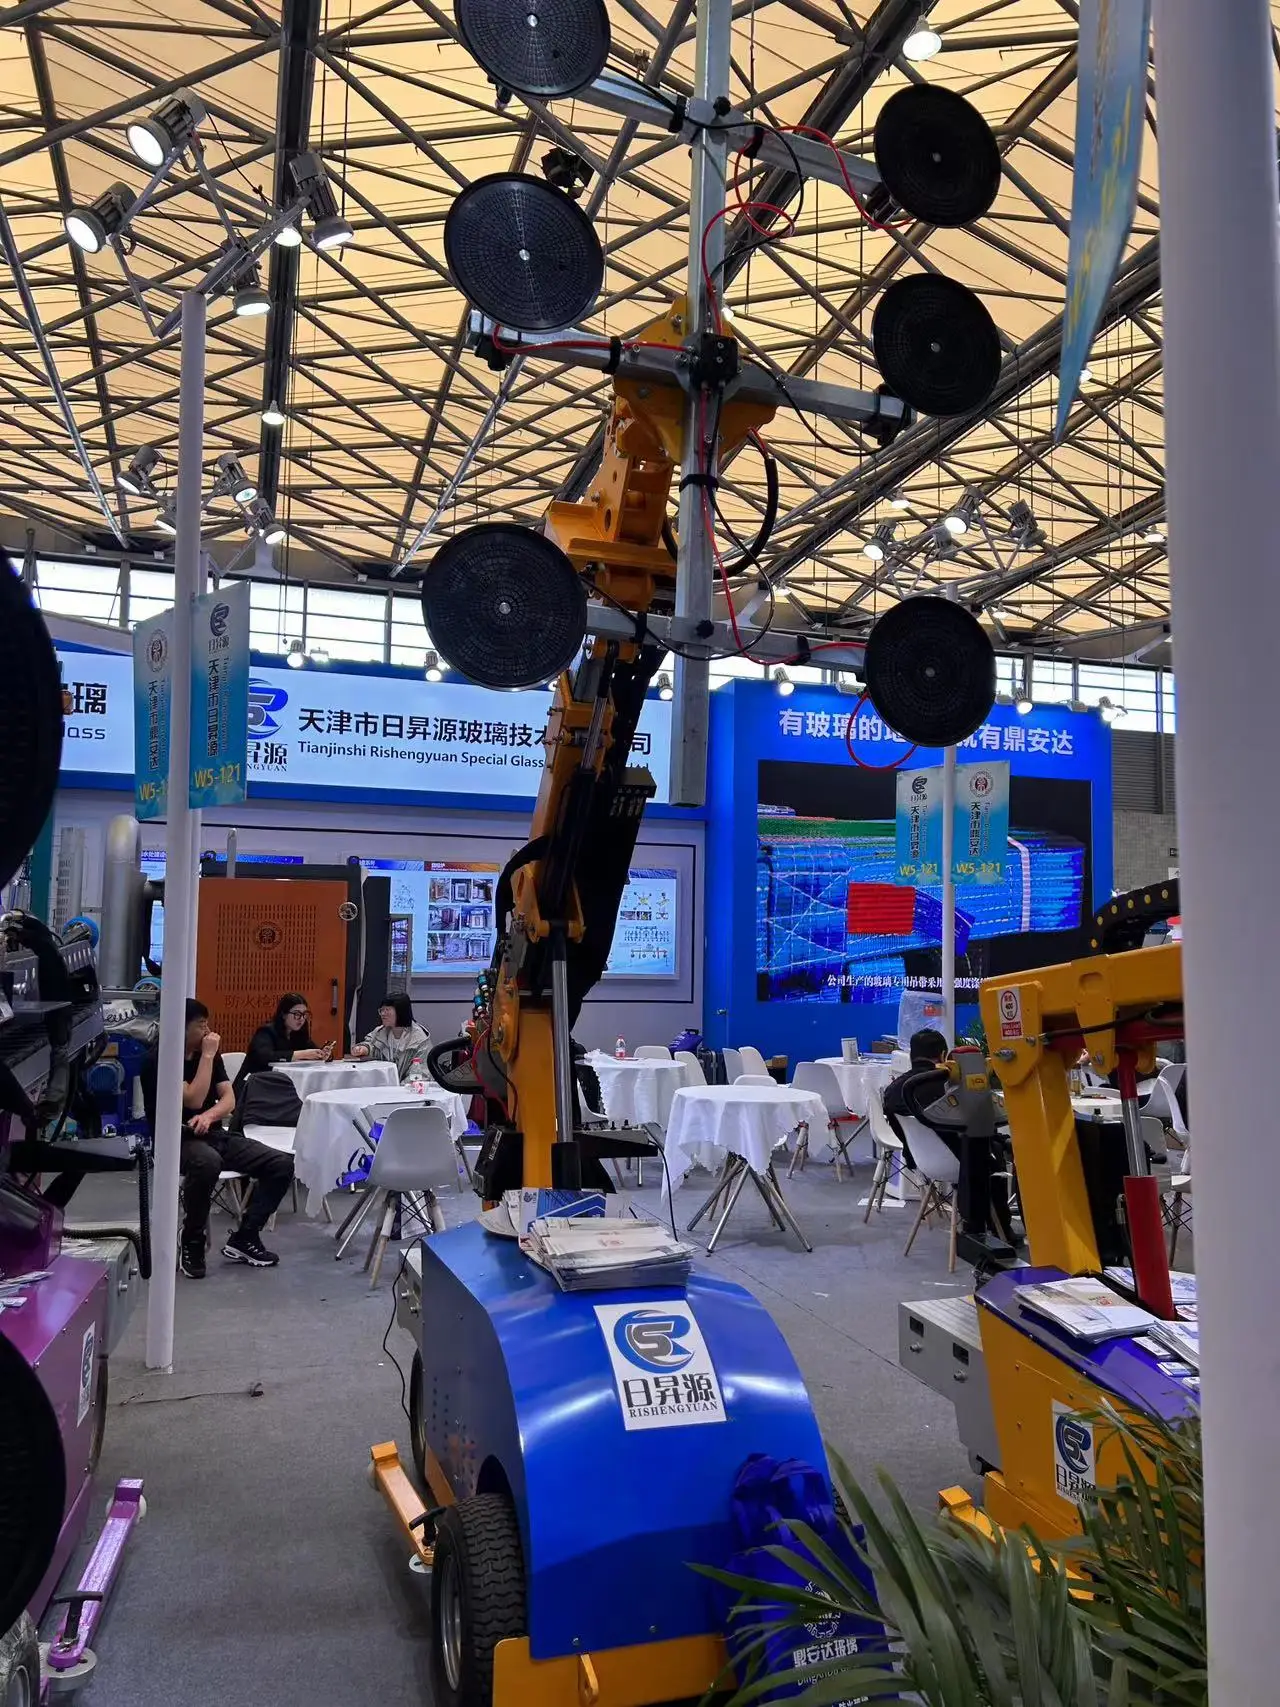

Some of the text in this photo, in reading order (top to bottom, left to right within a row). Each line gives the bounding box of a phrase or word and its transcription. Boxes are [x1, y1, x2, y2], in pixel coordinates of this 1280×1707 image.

[61, 681, 108, 715] 璃
[207, 657, 220, 757] 天津市日昇源
[61, 721, 106, 740] lass
[148, 680, 160, 771] 天津市鼎安达
[247, 741, 288, 765] 昇源
[298, 741, 545, 768] Tianjinshi Rishengyuan Special Glass
[194, 762, 241, 788] W5-121
[247, 763, 287, 772] NGYUAN
[900, 863, 938, 877] W5-121
[956, 863, 1001, 876] W5-121
[827, 974, 991, 990] 公司生产的玻璃专用吊带采用强度涤
[623, 1372, 716, 1408] 日昇源
[629, 1401, 718, 1418] RISHENGYUAN
[793, 1637, 859, 1668] 鼎安达玻璃
